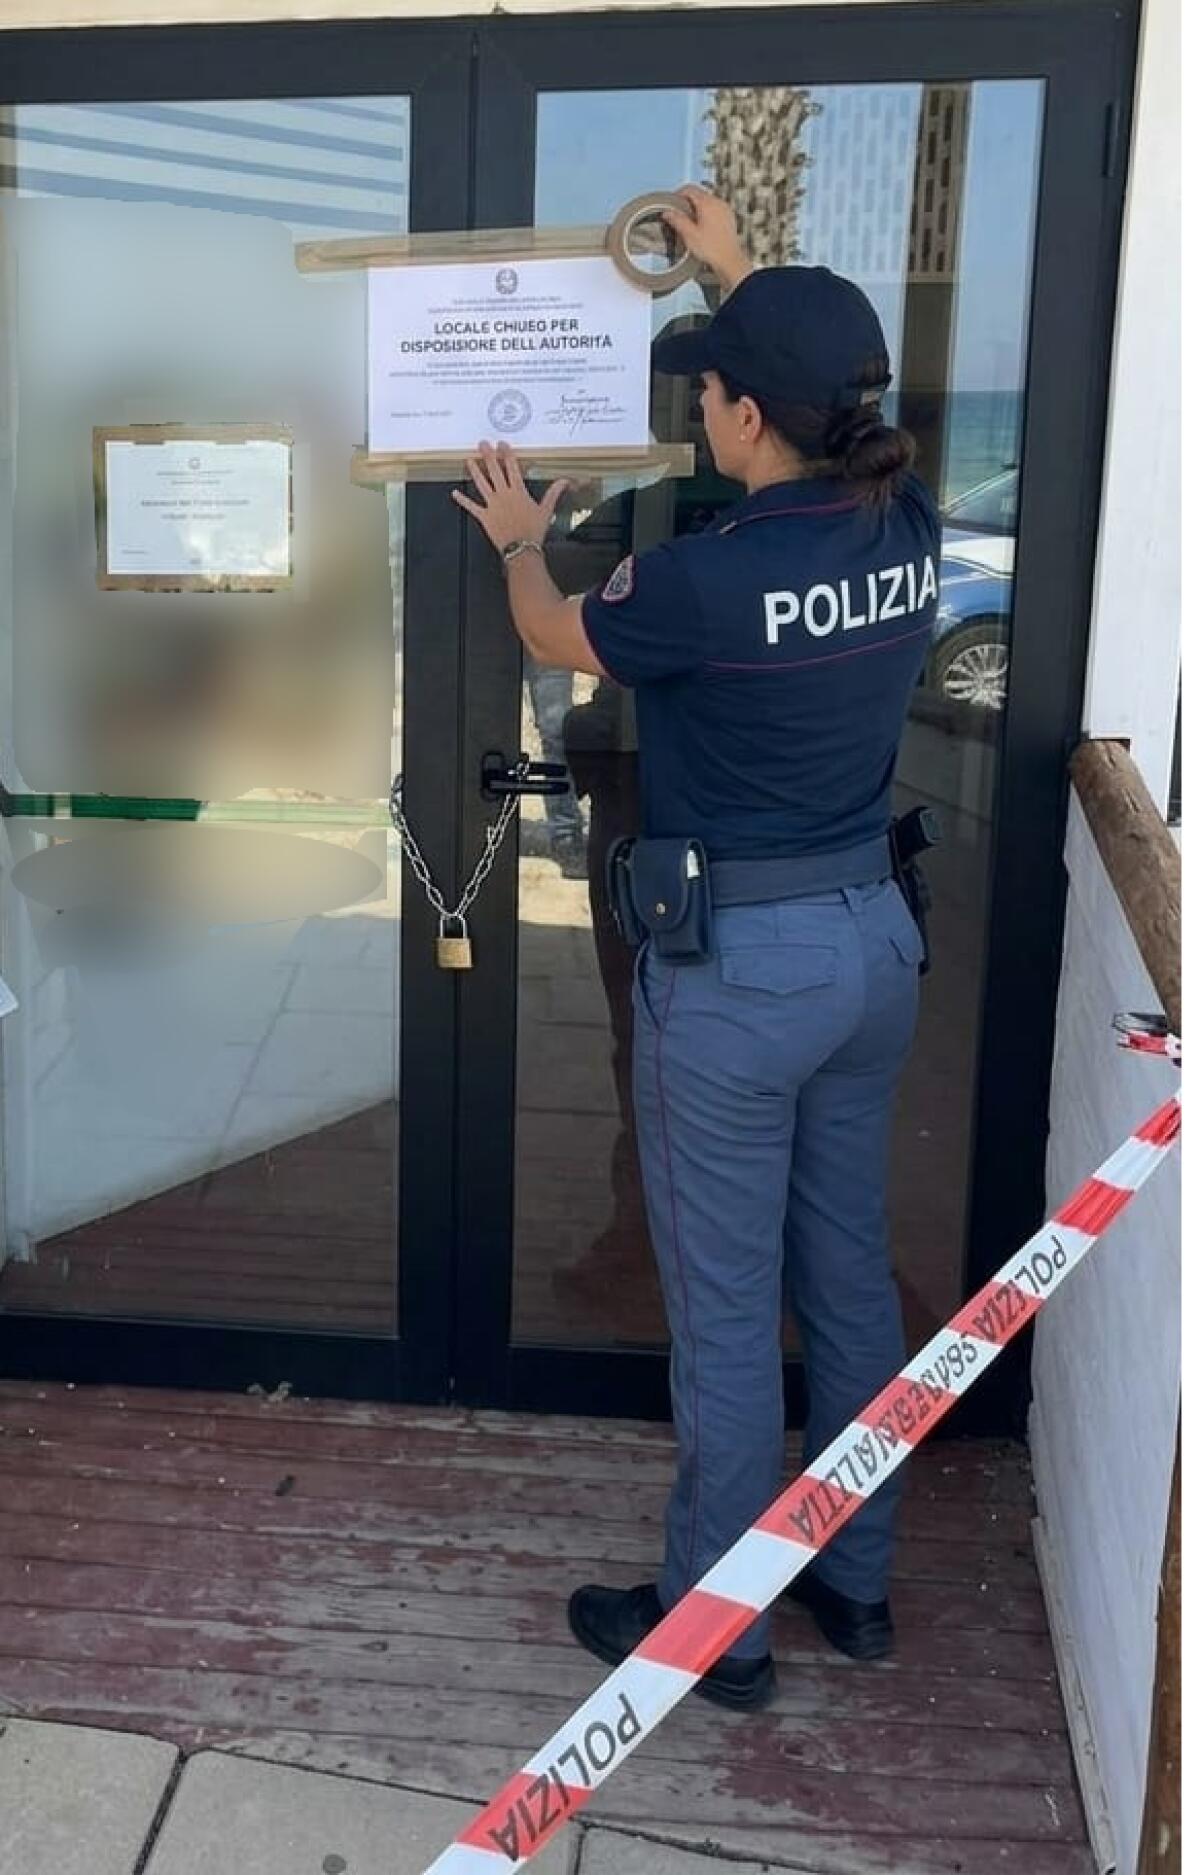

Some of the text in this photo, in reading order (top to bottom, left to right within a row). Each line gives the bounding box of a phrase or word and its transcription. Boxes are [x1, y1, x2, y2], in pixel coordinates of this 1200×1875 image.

[434, 322, 490, 334] LOCALE
[551, 318, 579, 332] PER
[763, 554, 938, 645] POLIZIA
[972, 1234, 1067, 1342] POLIZIA
[486, 1692, 642, 1863] POLIZIA
